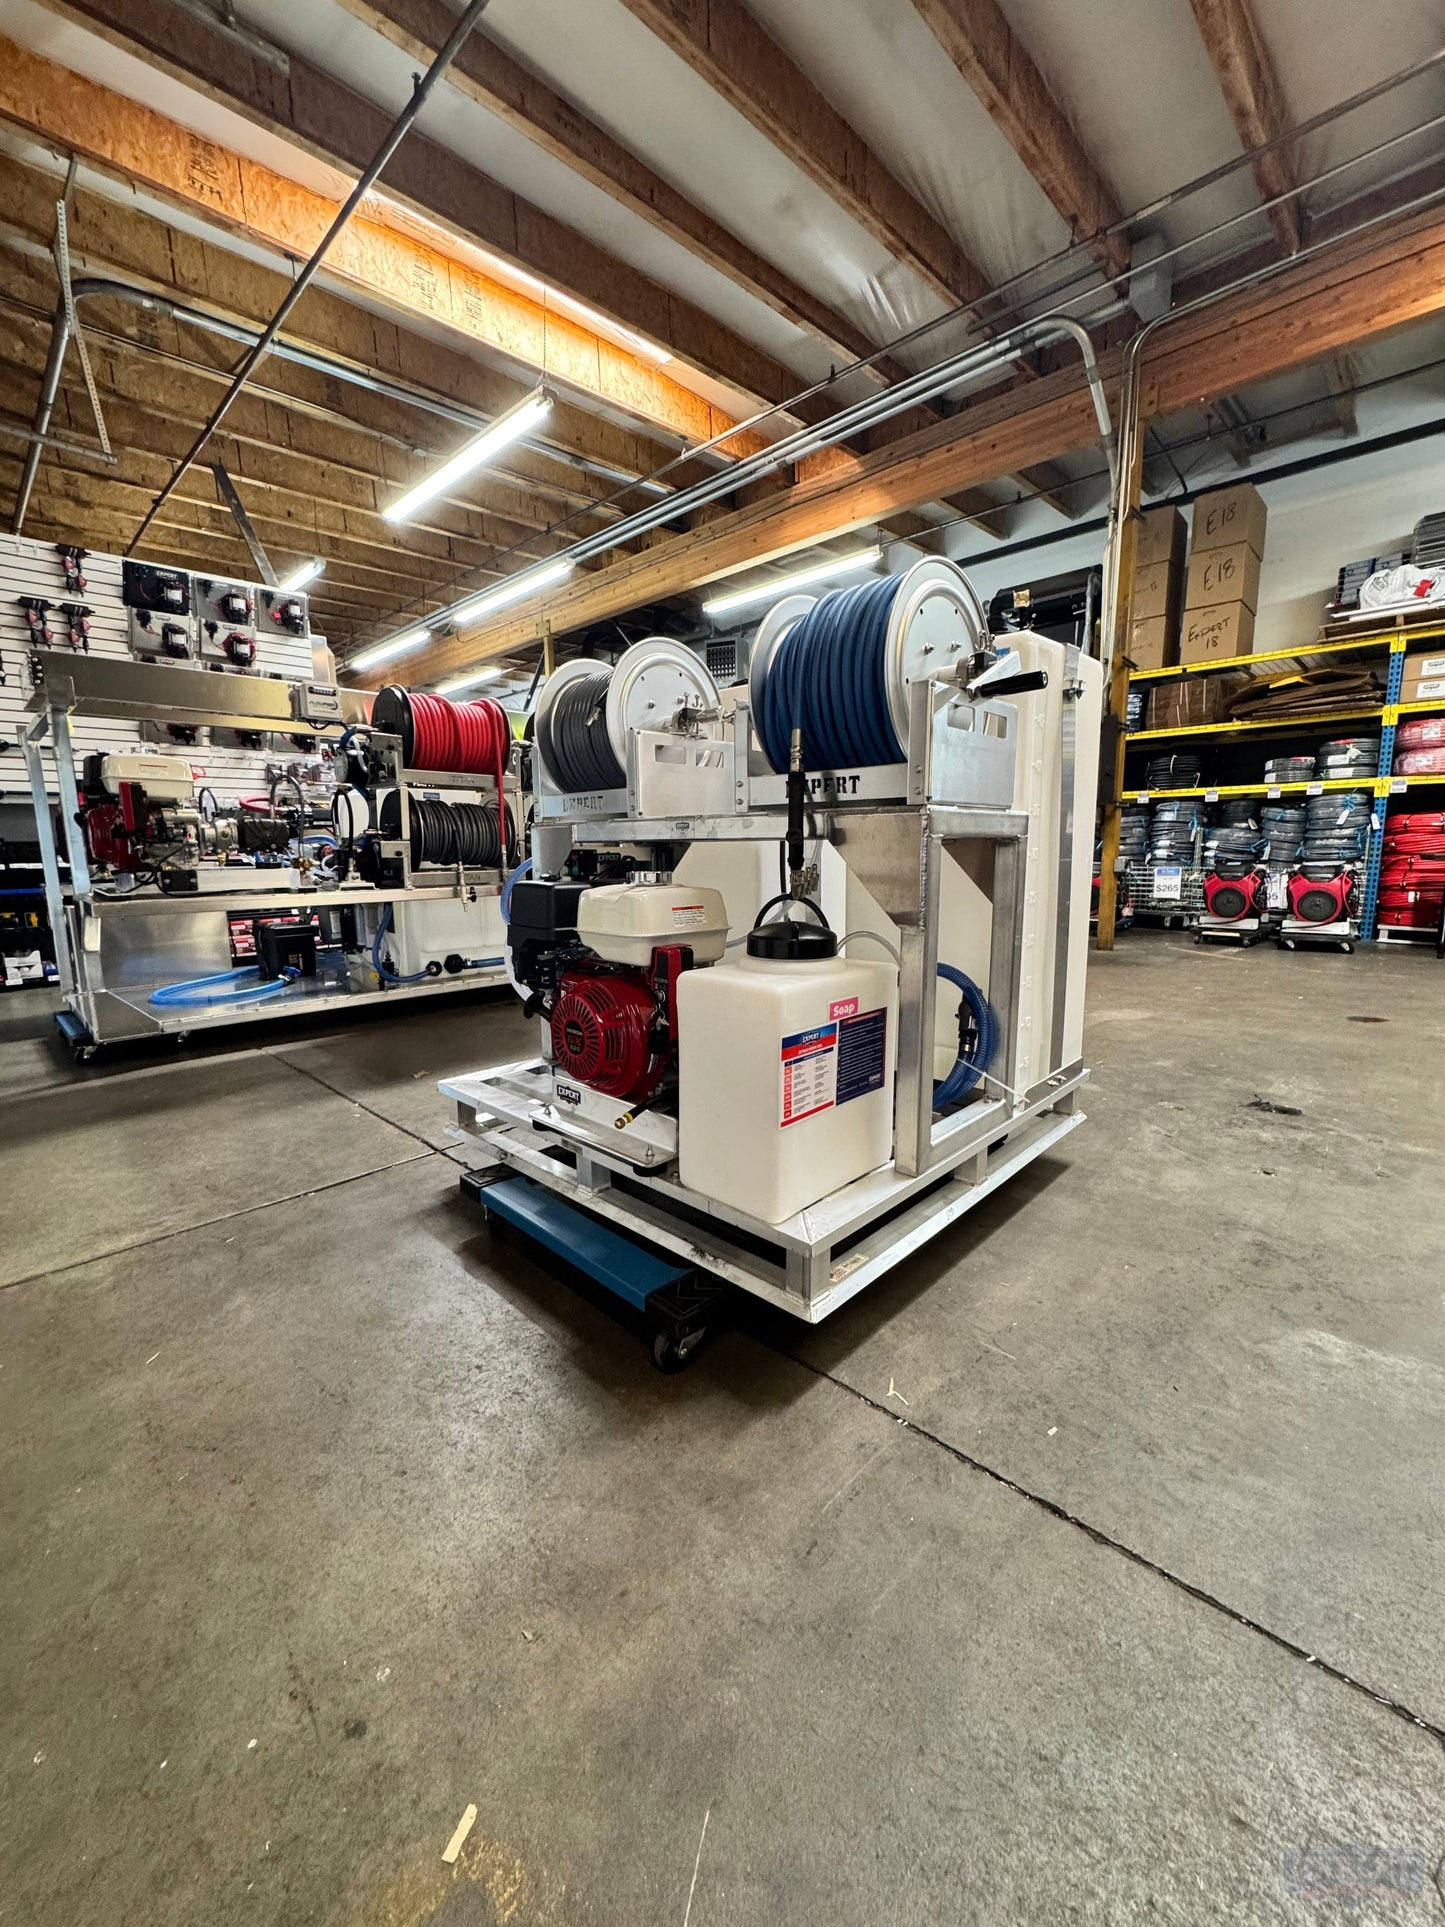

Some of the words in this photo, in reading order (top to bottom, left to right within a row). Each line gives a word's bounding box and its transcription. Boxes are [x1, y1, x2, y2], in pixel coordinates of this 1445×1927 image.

[1206, 637, 1218, 649] 18
[1155, 884, 1179, 892] $265
[833, 1004, 855, 1017] Soap
[802, 1033, 819, 1043] EXPERT
[558, 1087, 579, 1101] EXPERT
